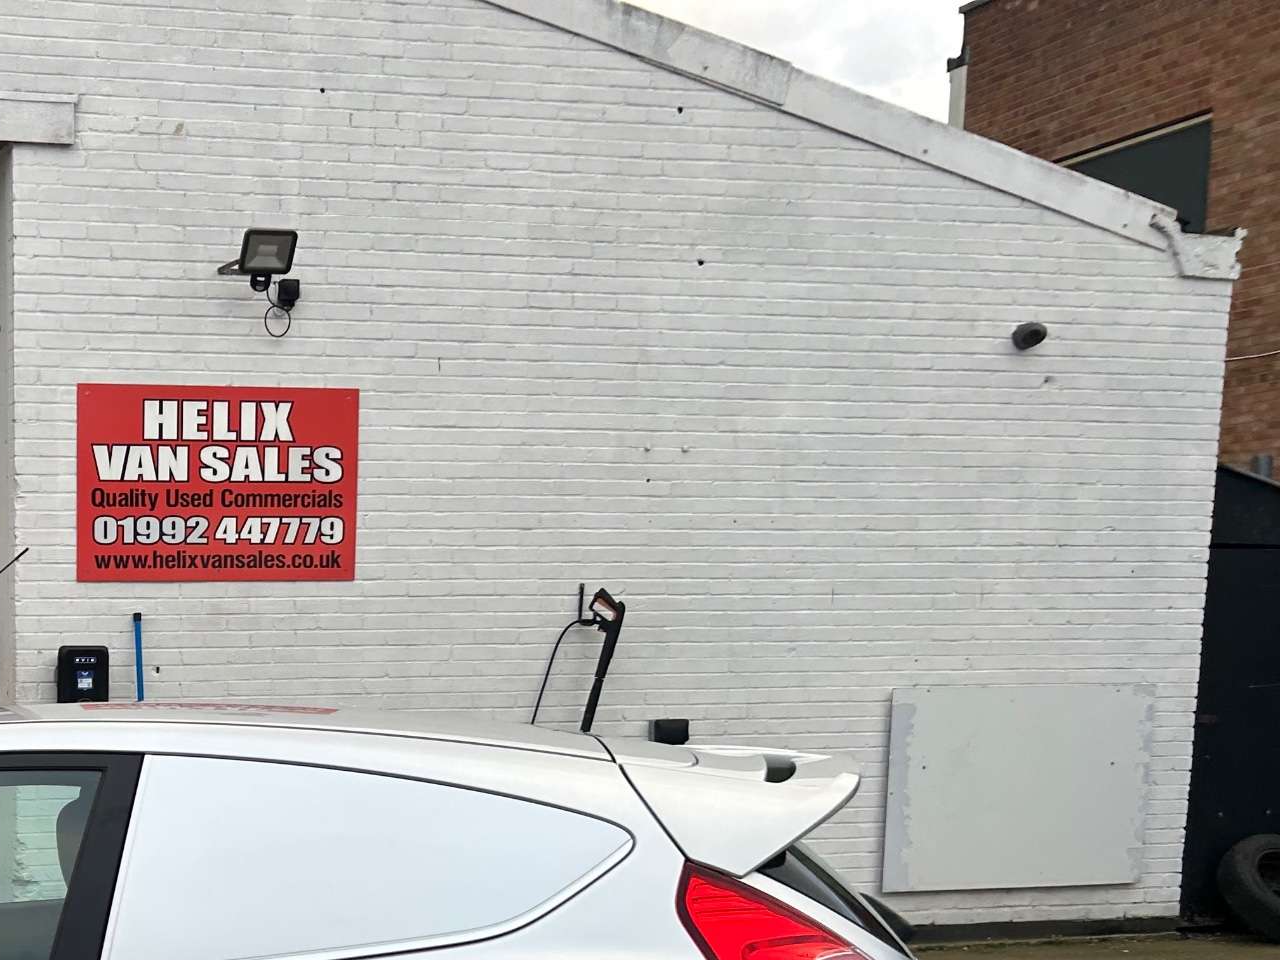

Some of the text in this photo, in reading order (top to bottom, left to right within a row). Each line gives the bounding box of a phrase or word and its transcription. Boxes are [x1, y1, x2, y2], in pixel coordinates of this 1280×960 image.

[142, 399, 295, 442] HELIX
[91, 444, 344, 484] VAN SALES
[91, 488, 344, 512] Quality Used Commercials
[92, 515, 345, 545] 01992 447779
[94, 550, 342, 570] www.helixvansales.co.uk
